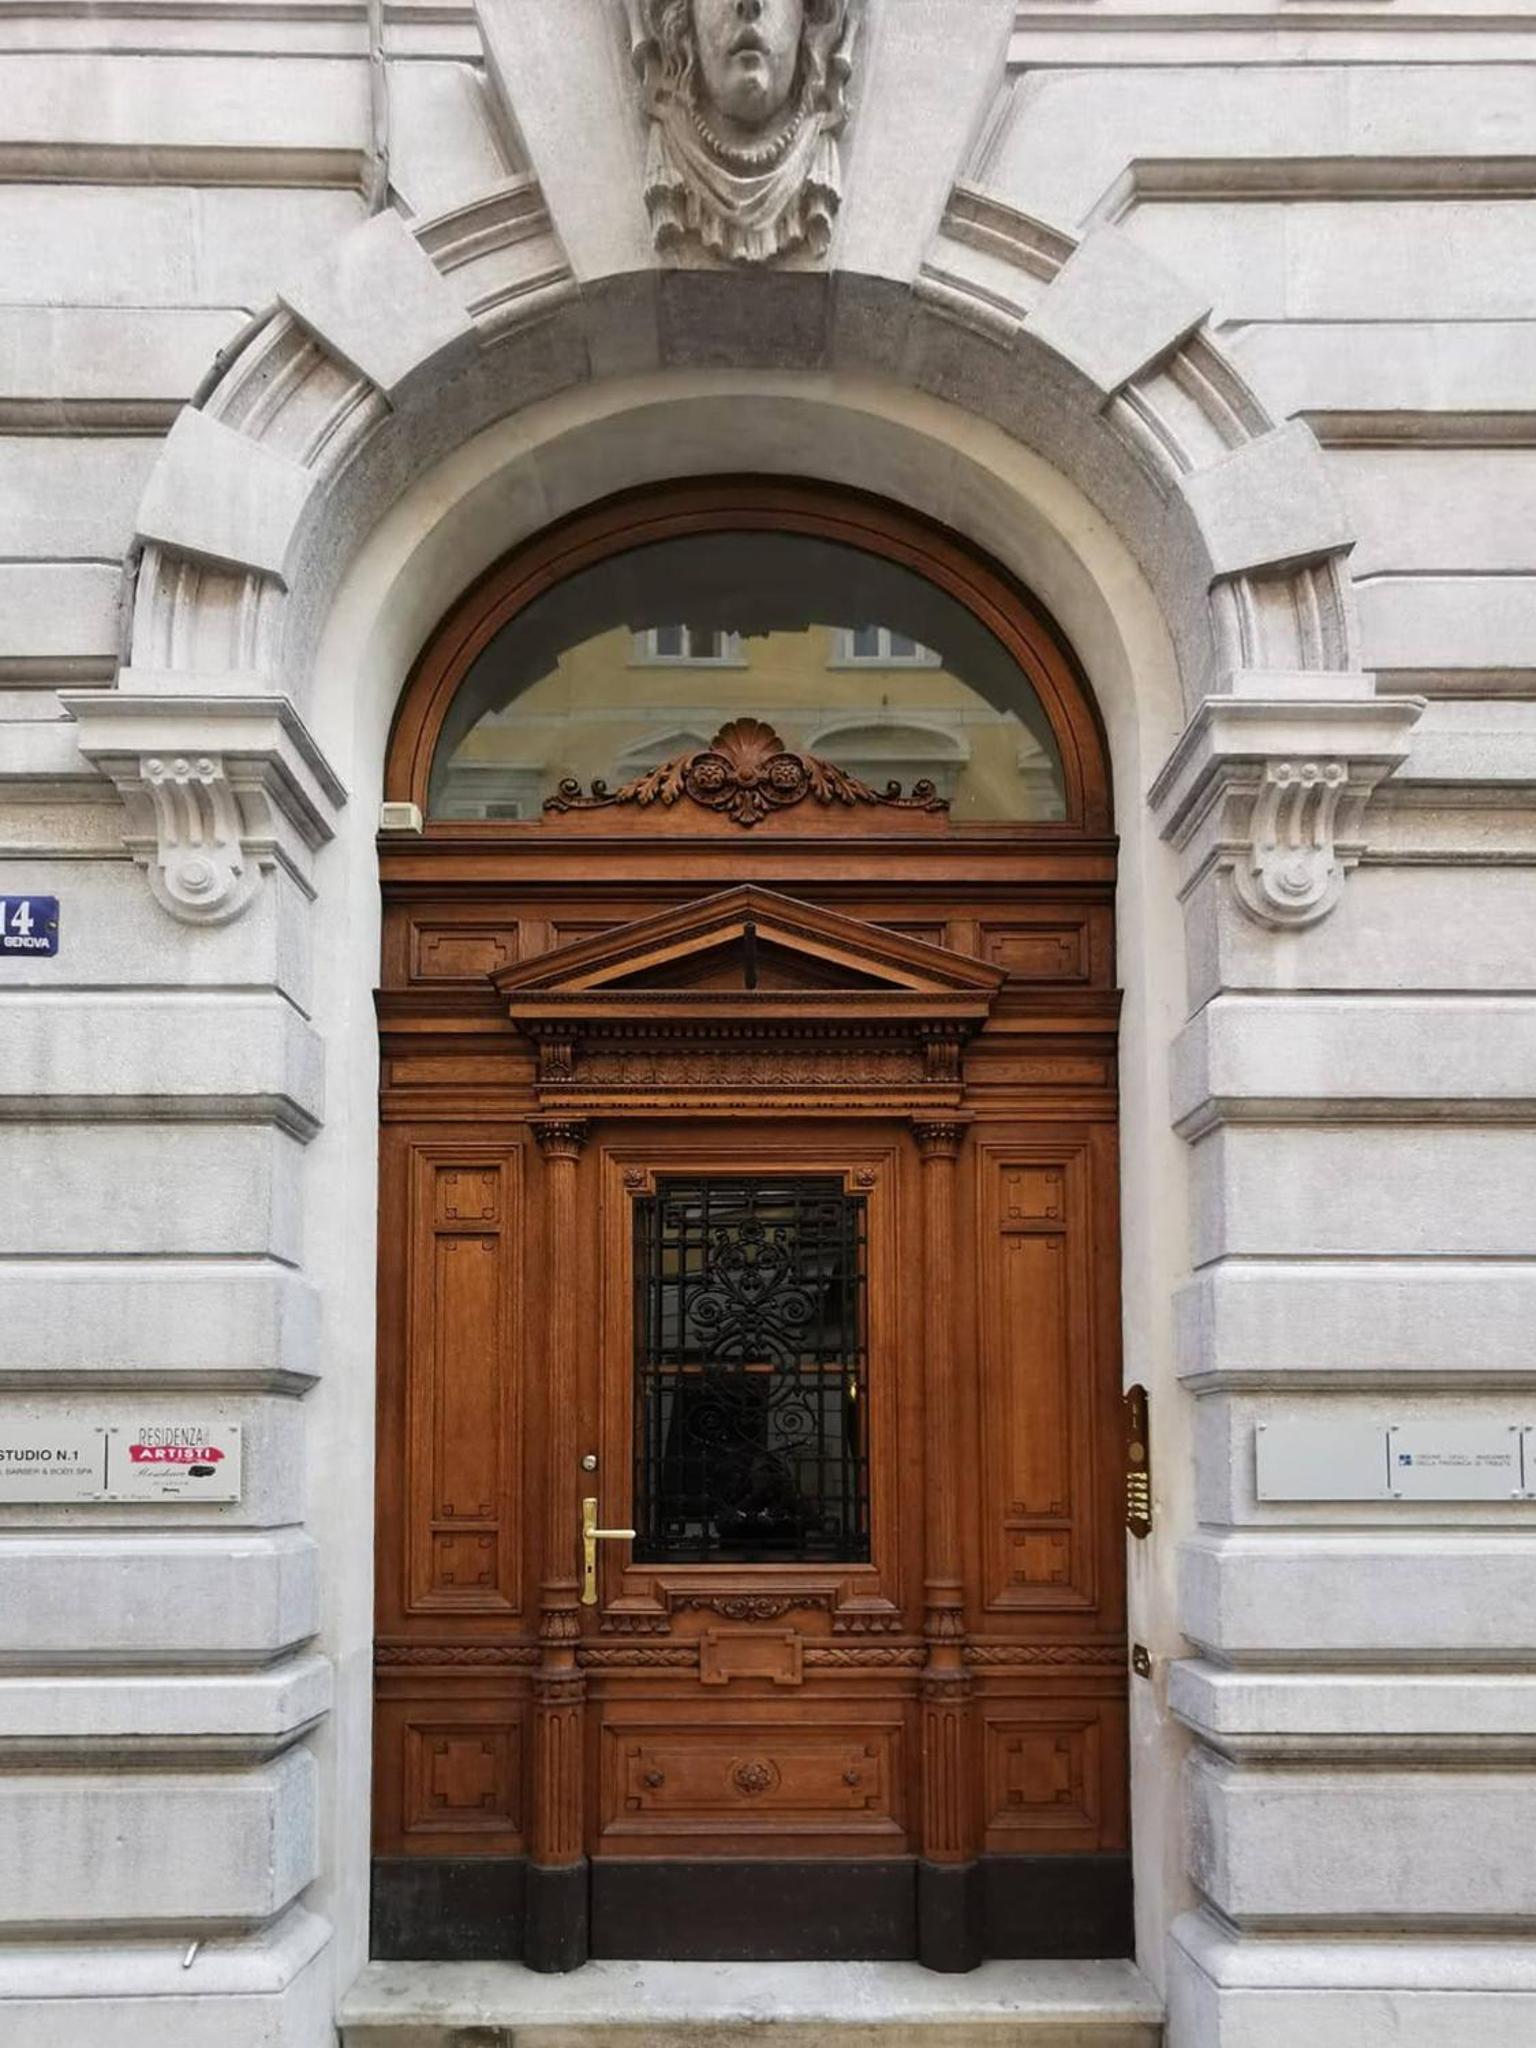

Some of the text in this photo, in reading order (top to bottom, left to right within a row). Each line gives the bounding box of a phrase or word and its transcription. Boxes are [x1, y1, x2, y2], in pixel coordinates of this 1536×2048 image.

[4, 936, 50, 948] GENOVA
[139, 1427, 203, 1446] RESIDENZA
[0, 1449, 79, 1461] STUDIO N.1
[140, 1448, 210, 1459] ARTISTI
